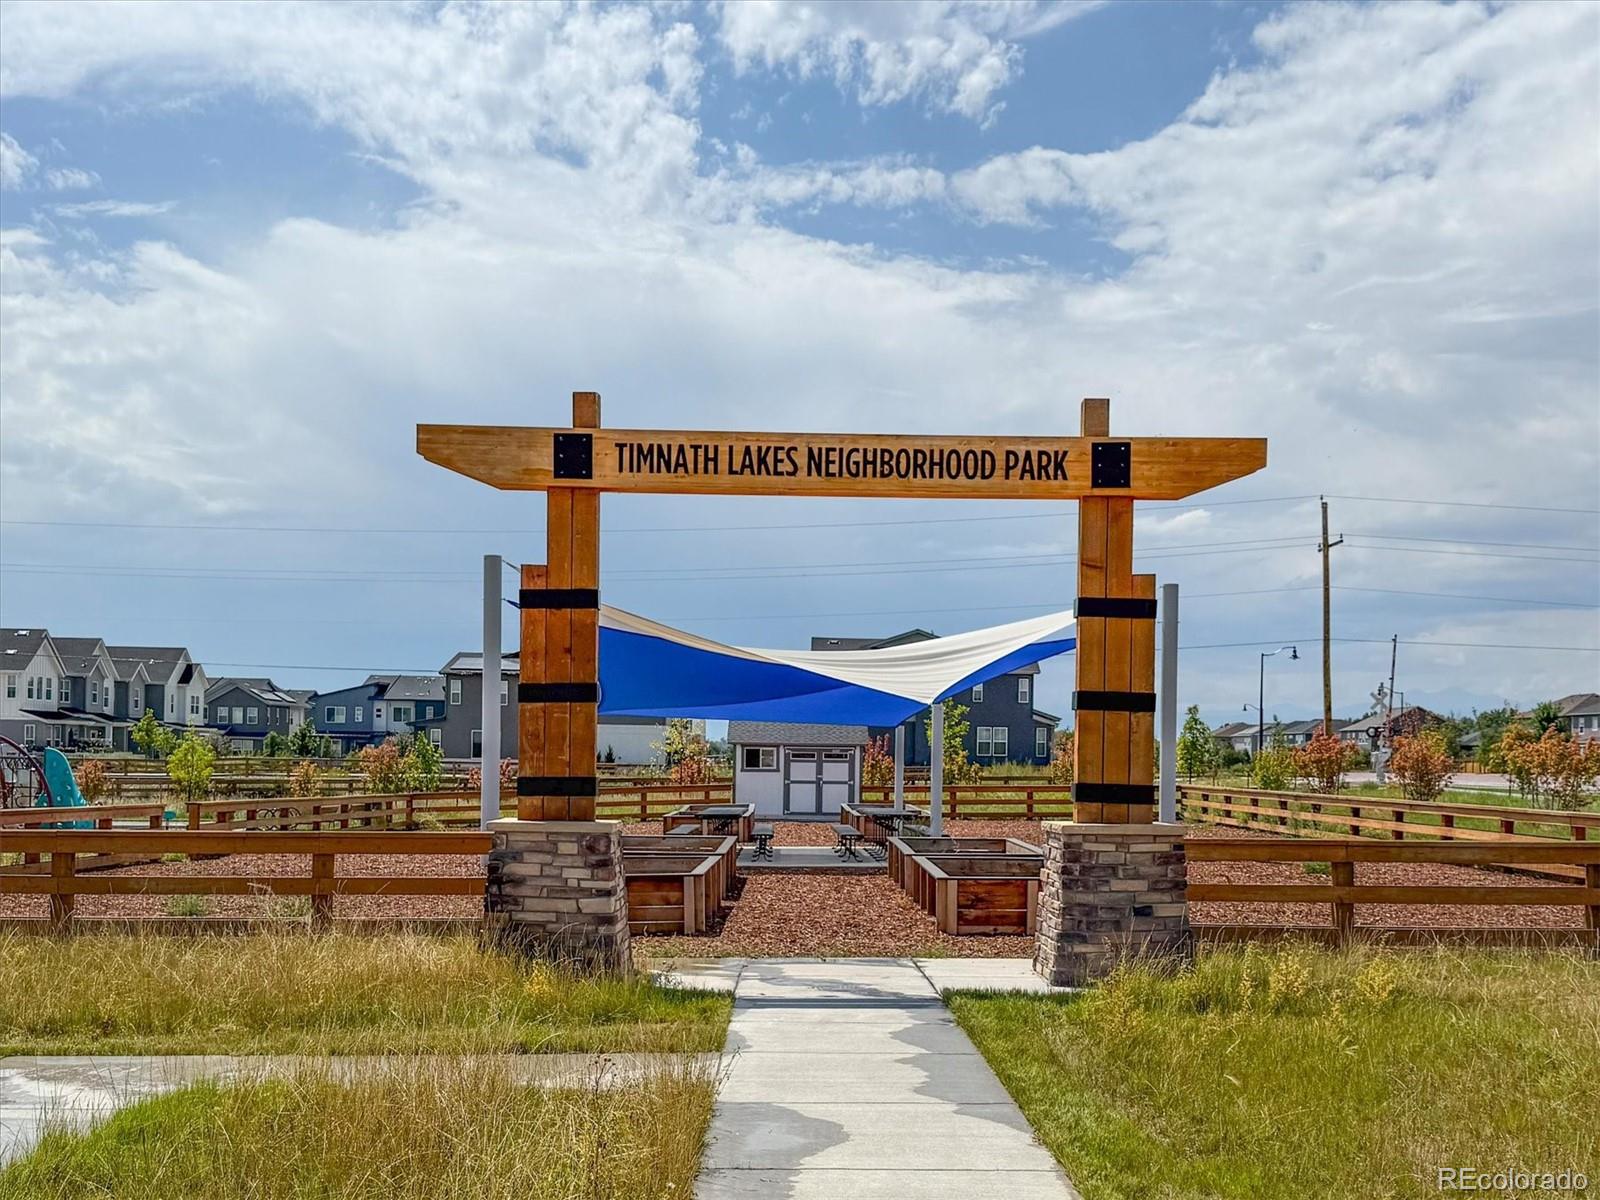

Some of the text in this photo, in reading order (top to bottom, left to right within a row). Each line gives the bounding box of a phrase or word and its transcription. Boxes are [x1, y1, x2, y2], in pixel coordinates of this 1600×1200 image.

[614, 442, 1069, 482] TIMNATH LAKES NEIGHBORHOOD PARK
